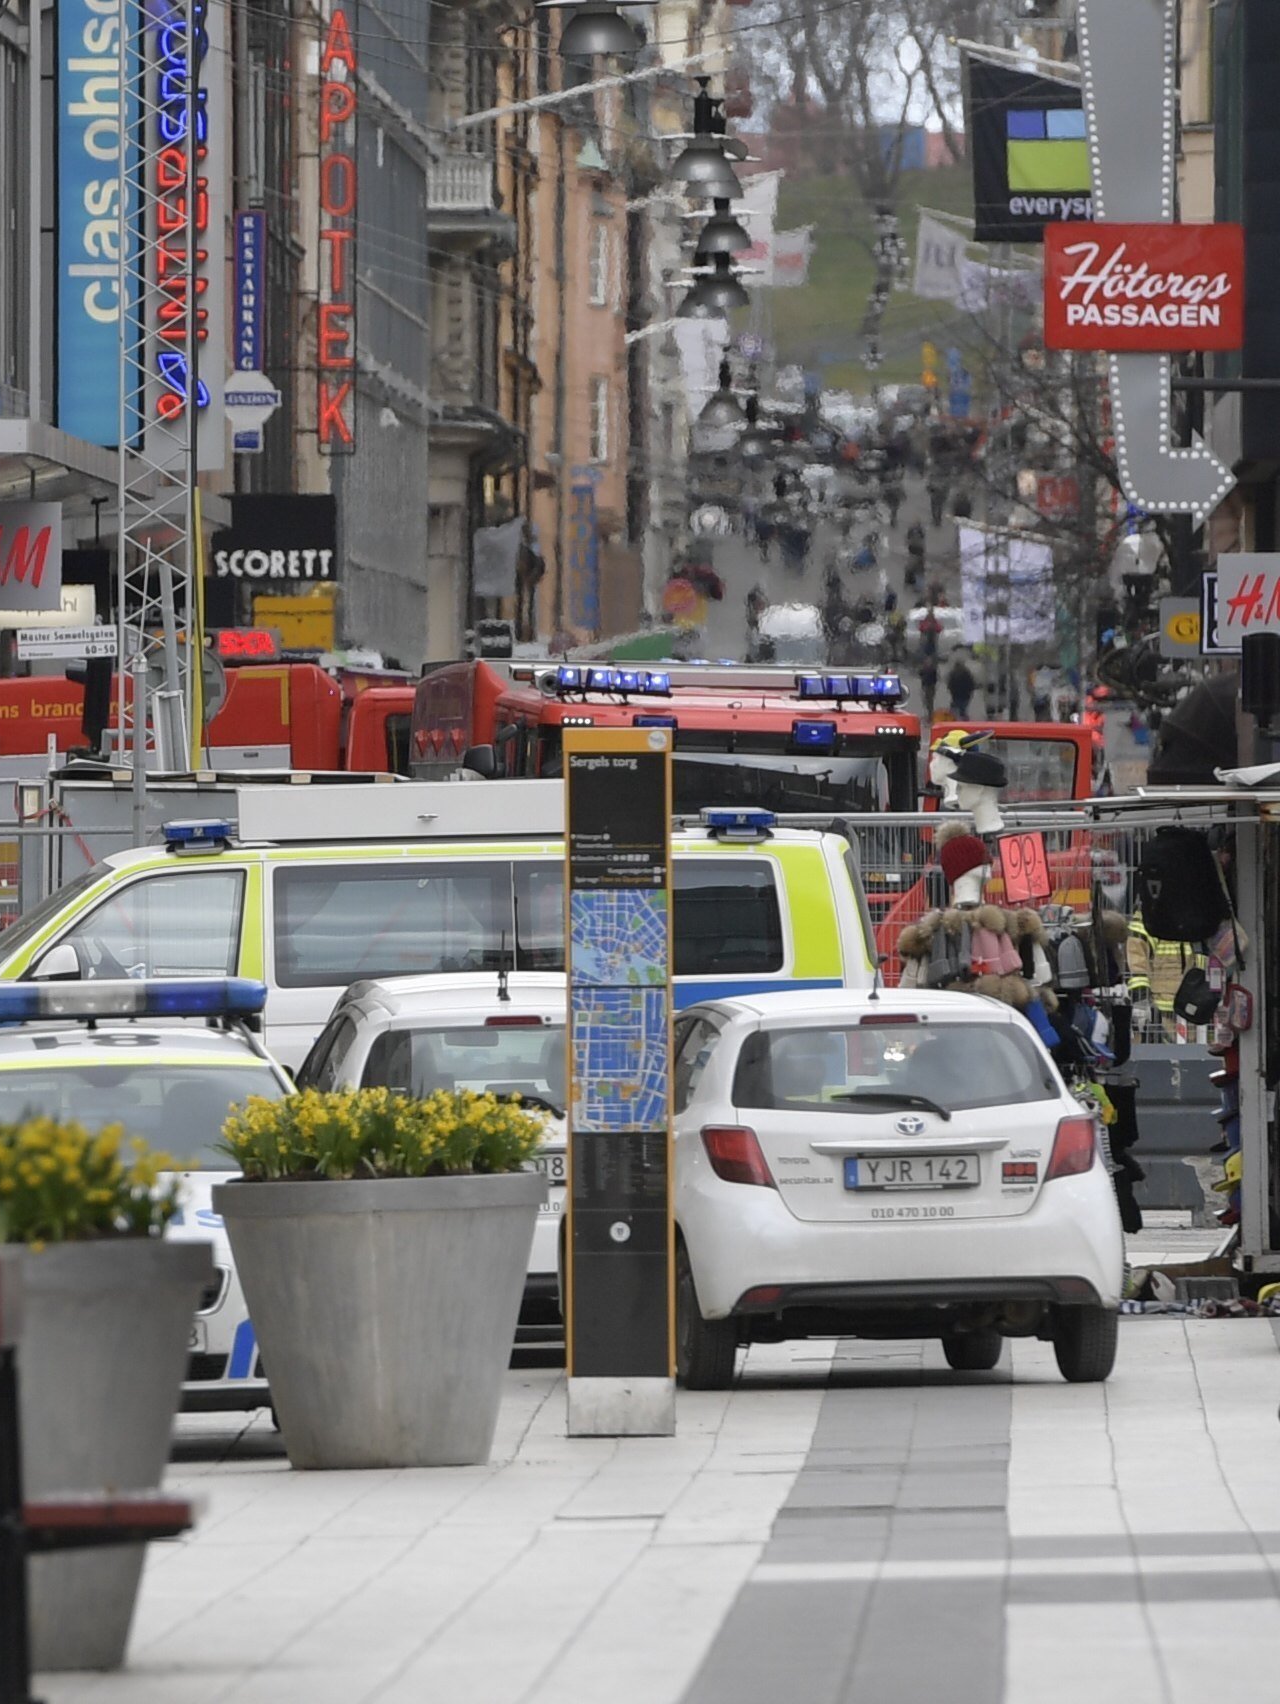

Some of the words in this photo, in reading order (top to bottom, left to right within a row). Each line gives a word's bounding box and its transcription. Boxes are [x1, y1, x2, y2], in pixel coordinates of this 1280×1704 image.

[320, 9, 356, 444] APOTEK
[68, 180, 129, 324] clas
[1060, 242, 1231, 304] Hötorgs
[241, 216, 255, 370] RESTAURANG
[1067, 304, 1220, 326] PASSAGEN
[215, 548, 333, 579] SCORETT
[54, 629, 115, 642] Samuelsgatan
[85, 644, 116, 655] 60-50
[570, 756, 610, 770] Sergels
[613, 757, 638, 770] torg
[866, 1160, 914, 1183] YJR
[923, 1159, 969, 1181] 142
[871, 1208, 895, 1219] 010
[897, 1207, 919, 1218] 470
[922, 1206, 937, 1217] 10
[939, 1205, 955, 1217] 00
